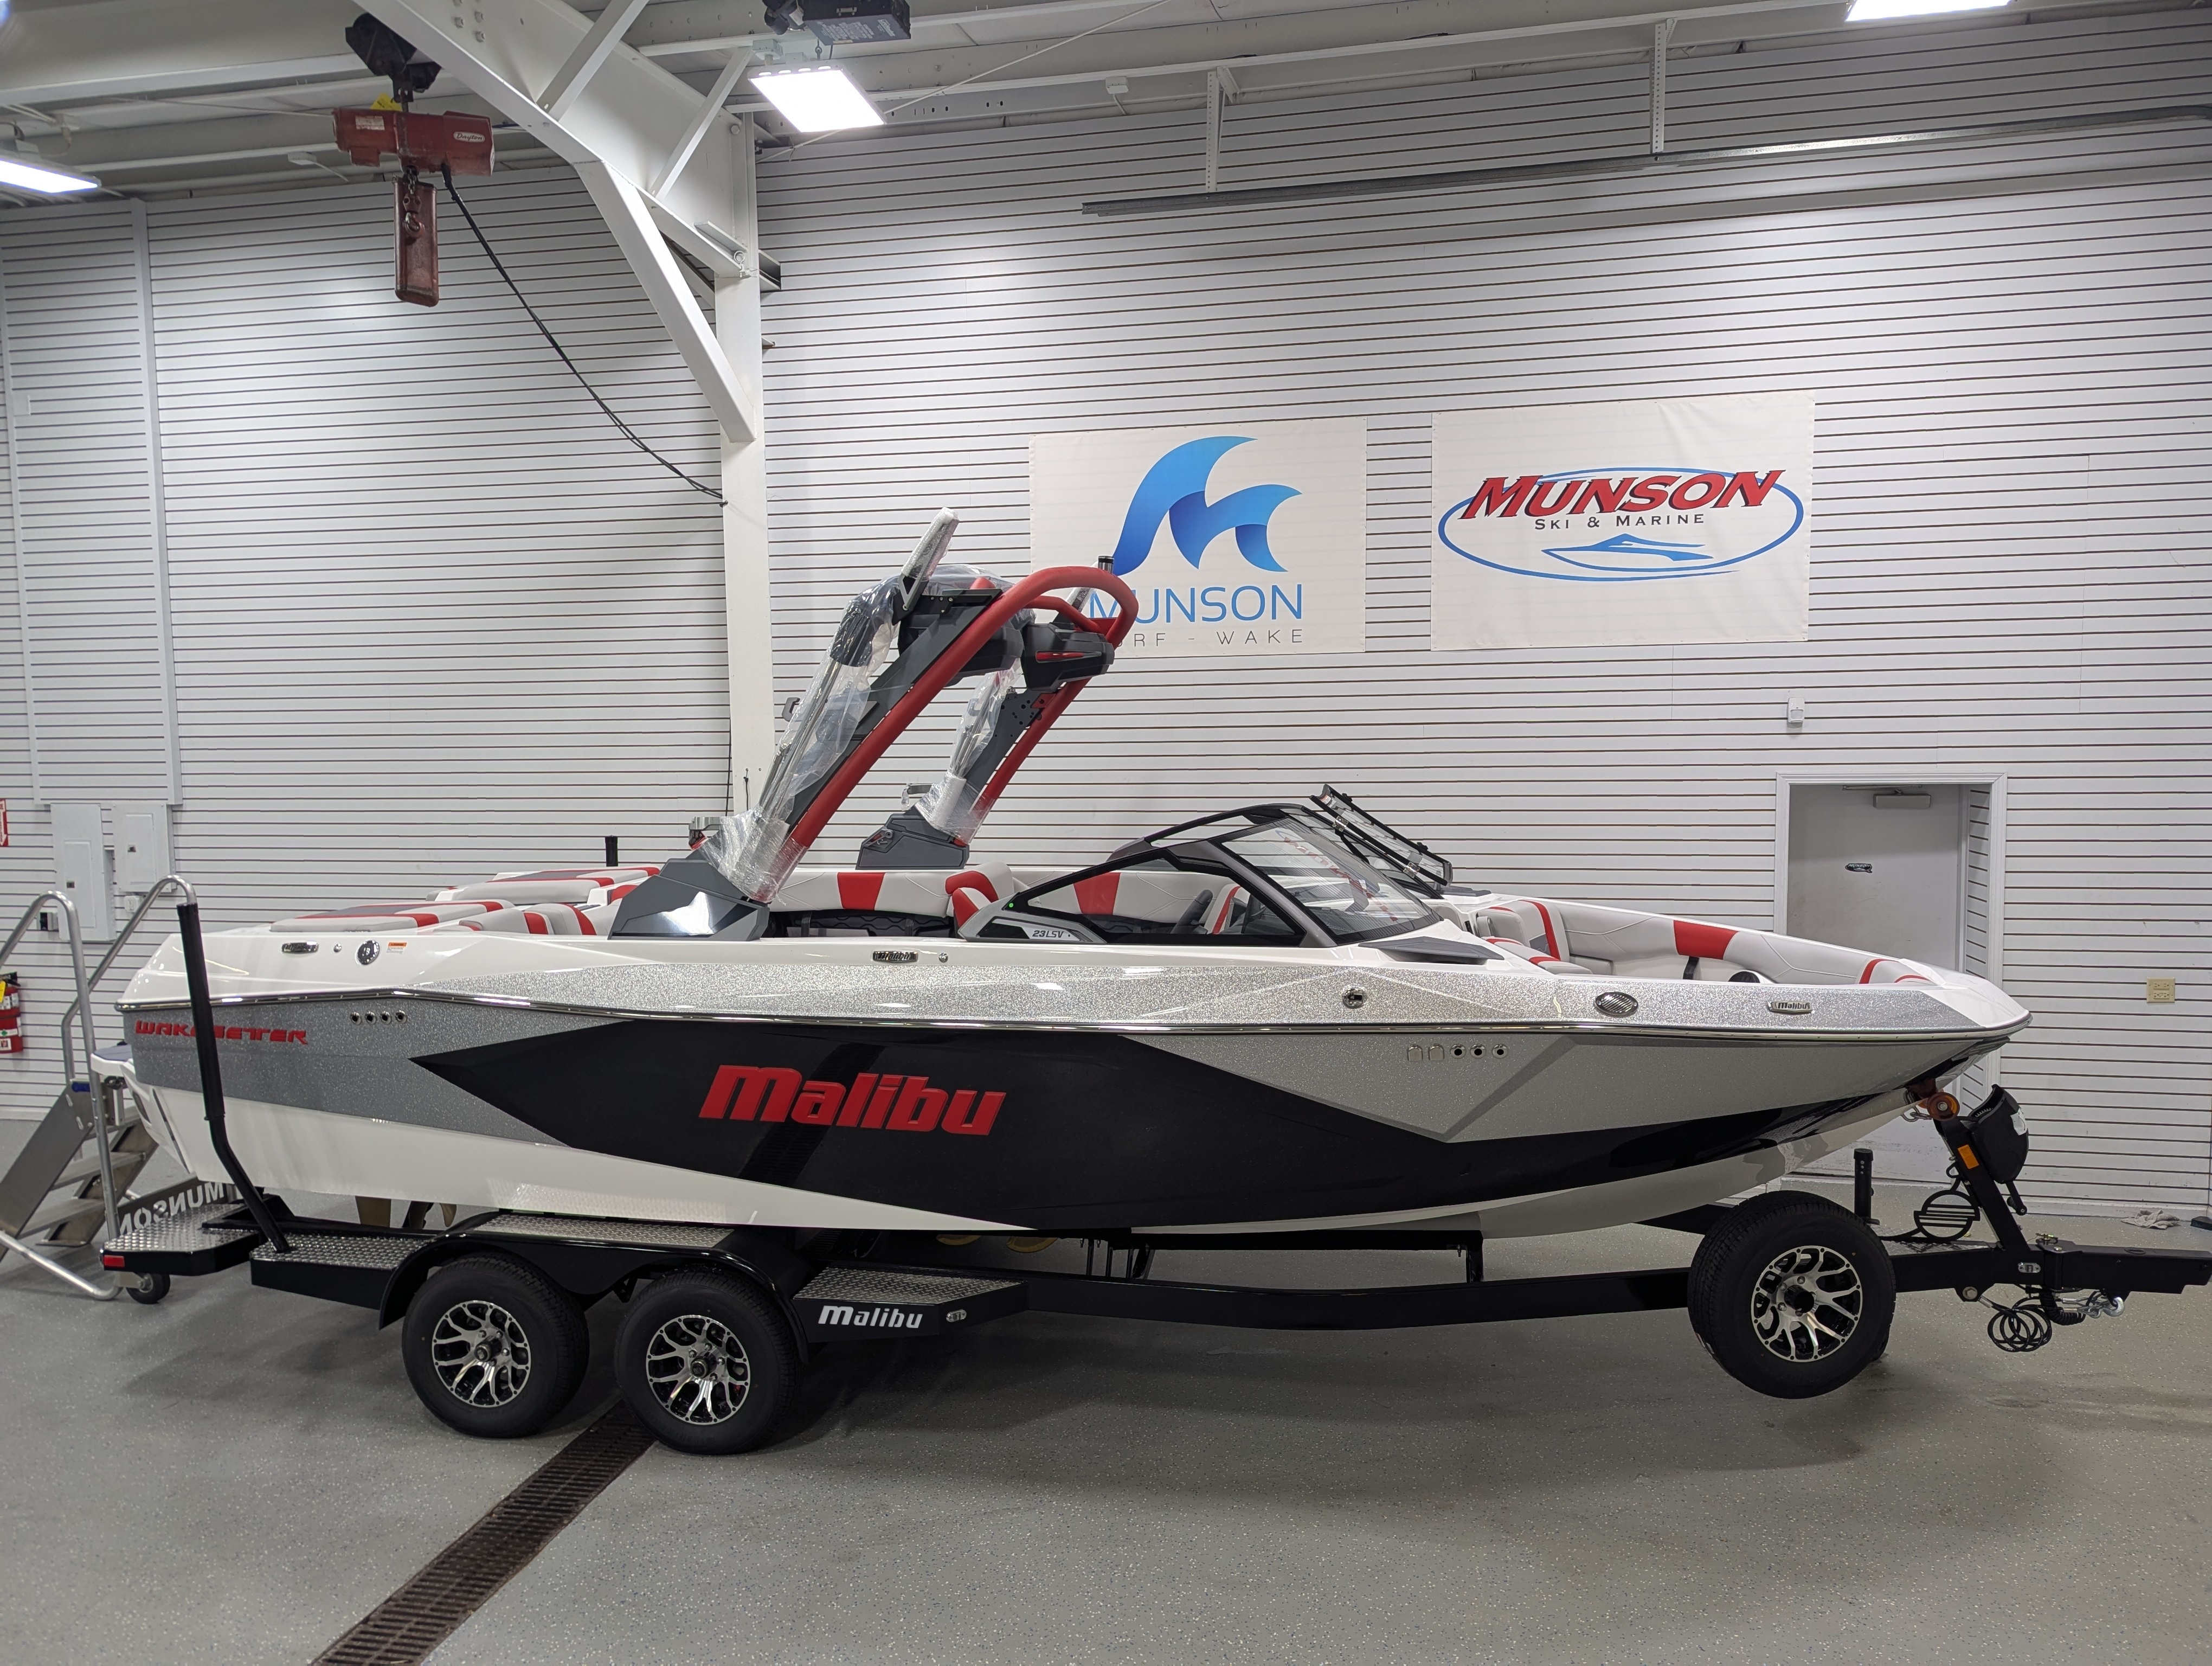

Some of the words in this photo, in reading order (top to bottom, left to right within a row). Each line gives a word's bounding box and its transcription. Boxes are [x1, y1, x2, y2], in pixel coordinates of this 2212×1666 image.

[456, 132, 483, 142] Dayton
[1458, 470, 1786, 519] MUNSON
[1587, 516, 1600, 528] &
[1090, 584, 1302, 624] MUNSON
[1217, 629, 1303, 645] WAKE
[1032, 930, 1064, 938] 23LSV
